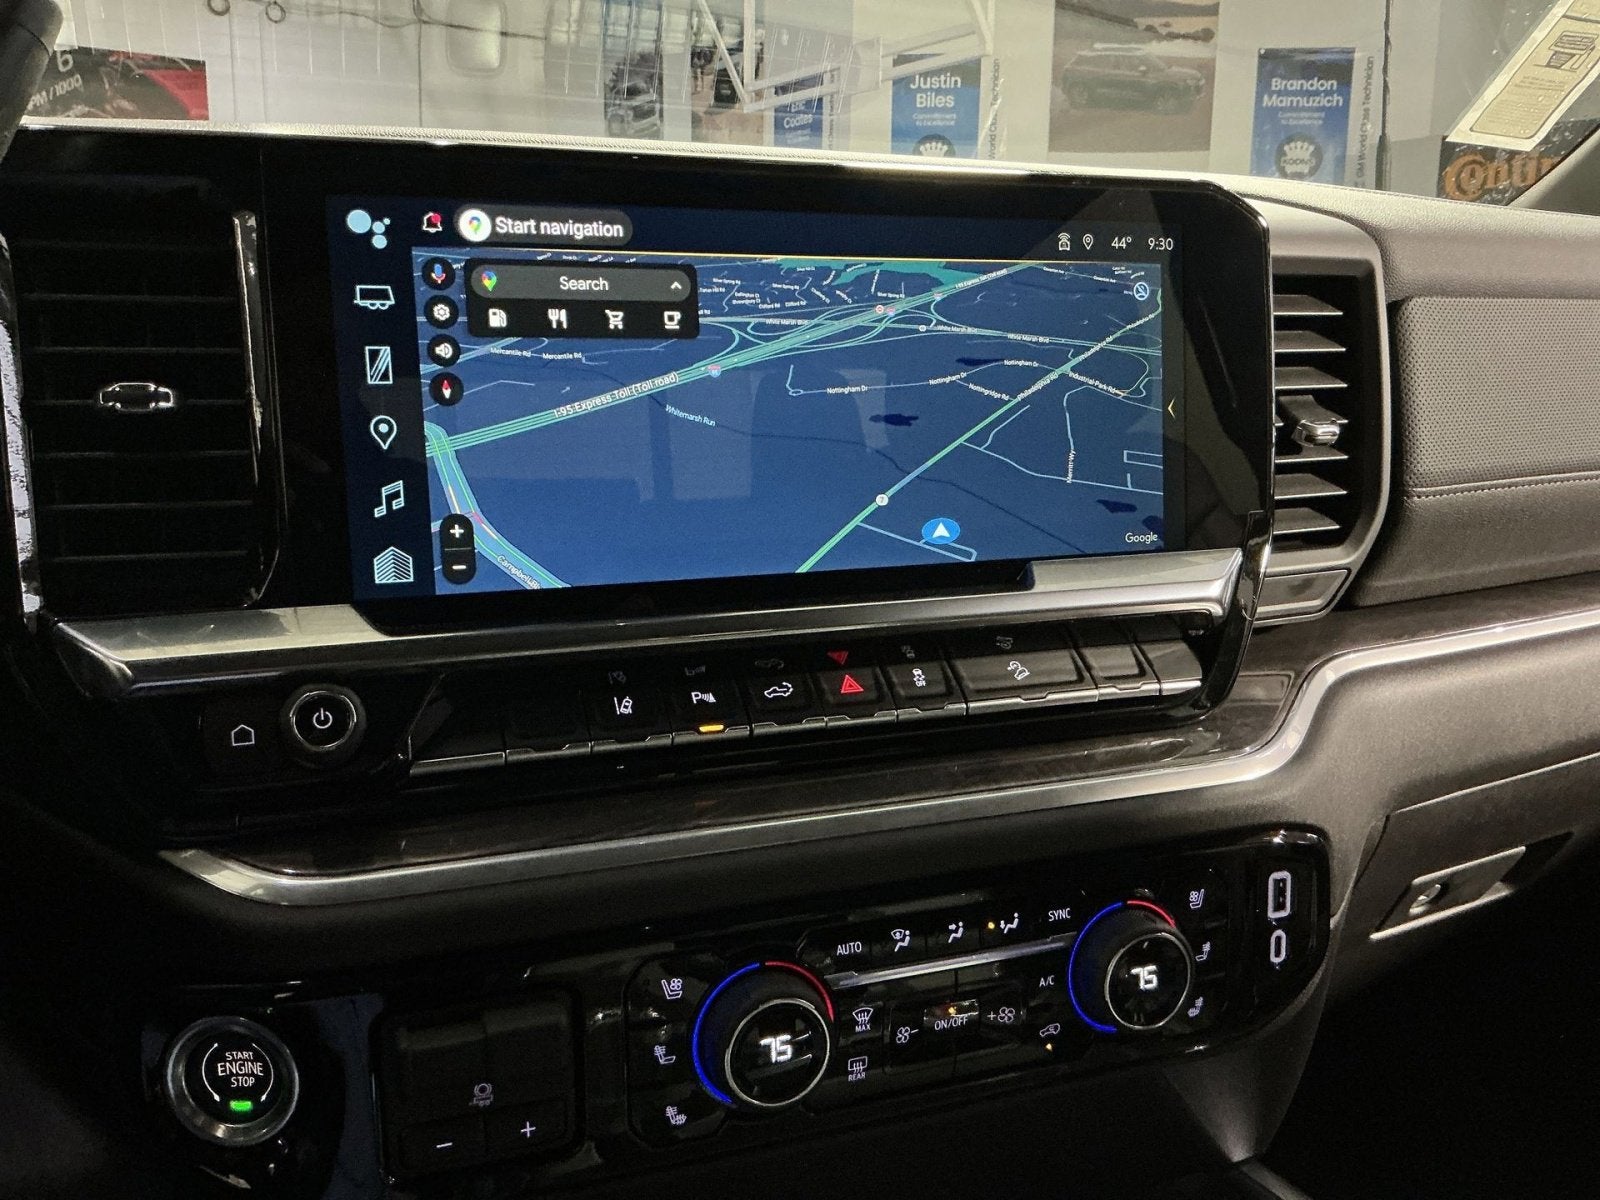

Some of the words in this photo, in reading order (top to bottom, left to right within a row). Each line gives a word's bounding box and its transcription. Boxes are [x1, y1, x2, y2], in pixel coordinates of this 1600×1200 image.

[910, 72, 962, 89] Justin
[1271, 77, 1338, 91] Brandon
[1362, 56, 1374, 106] Technician
[916, 91, 955, 108] Biles
[1262, 93, 1343, 108] Mamuzich
[1357, 134, 1368, 161] World
[495, 216, 537, 235] Start
[540, 219, 624, 240] navigation
[1148, 237, 1174, 251] 9:30
[559, 276, 609, 291] Search
[490, 348, 522, 357] Mercantile
[522, 350, 532, 358] Rd
[543, 352, 573, 360] Mercantile
[1004, 359, 1032, 367] Nottingham
[929, 374, 960, 386] Nottingham
[554, 405, 573, 418] I-95
[575, 394, 612, 412] Express
[613, 387, 631, 400] Toll
[632, 381, 652, 396] (Toll
[653, 371, 679, 388] road)
[827, 386, 860, 395] Nottingham
[666, 404, 702, 424] Whitemarsh
[703, 417, 716, 427] Run
[1125, 532, 1158, 544] Google
[497, 555, 532, 585] Campbell
[1048, 908, 1071, 921] SYNC
[836, 941, 862, 956] AUTO
[1039, 975, 1055, 987] A/C
[1130, 965, 1159, 991] 75
[855, 1024, 871, 1033] MAX
[934, 1016, 969, 1031] ON/OFF
[225, 1051, 253, 1060] START
[760, 1034, 793, 1064] 75
[217, 1061, 264, 1076] ENGINE
[230, 1076, 255, 1087] STOP
[848, 1072, 866, 1081] REAR
